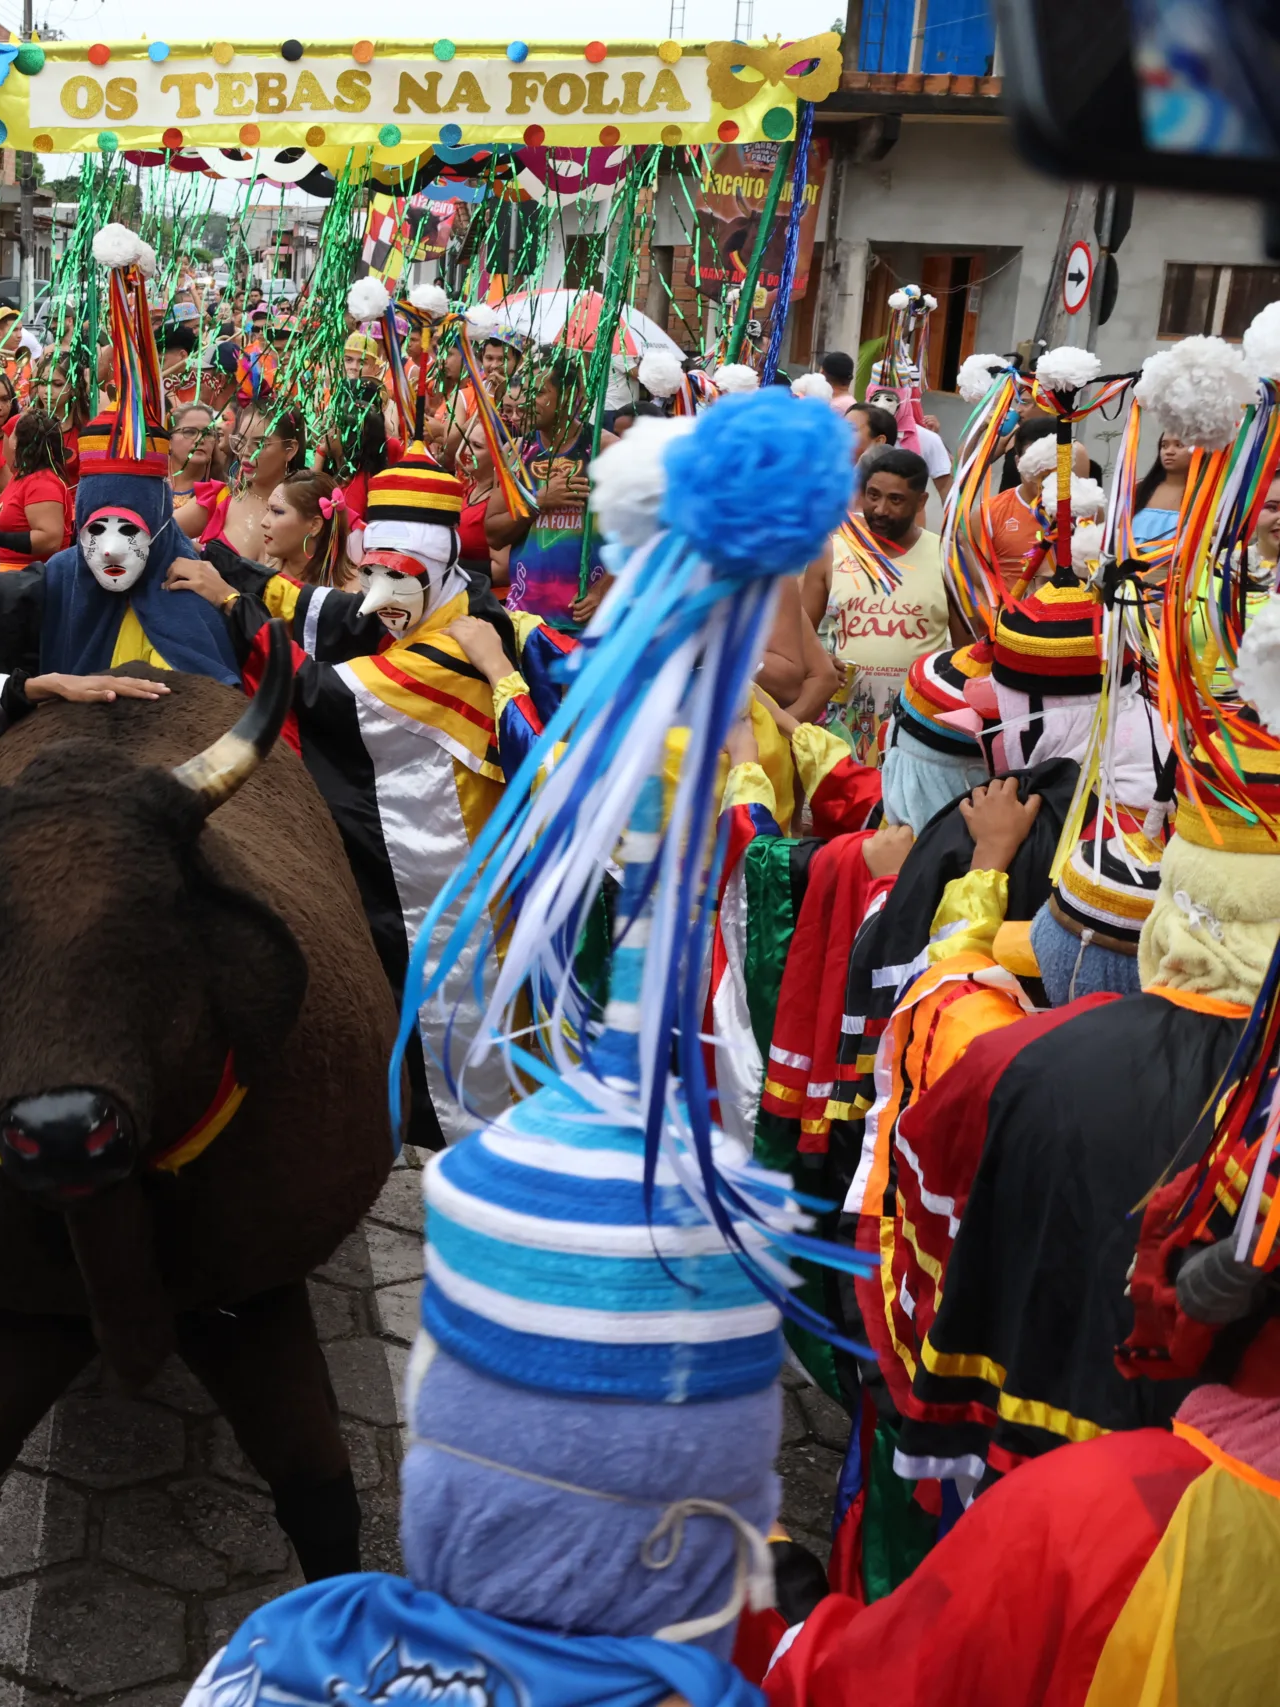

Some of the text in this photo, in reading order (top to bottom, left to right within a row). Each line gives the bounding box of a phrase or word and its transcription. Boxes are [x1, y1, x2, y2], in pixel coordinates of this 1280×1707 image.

[60, 68, 692, 120] OS TEBAS NA FOLIA
[704, 170, 765, 199] Faceiro
[551, 514, 583, 529] FOLIA
